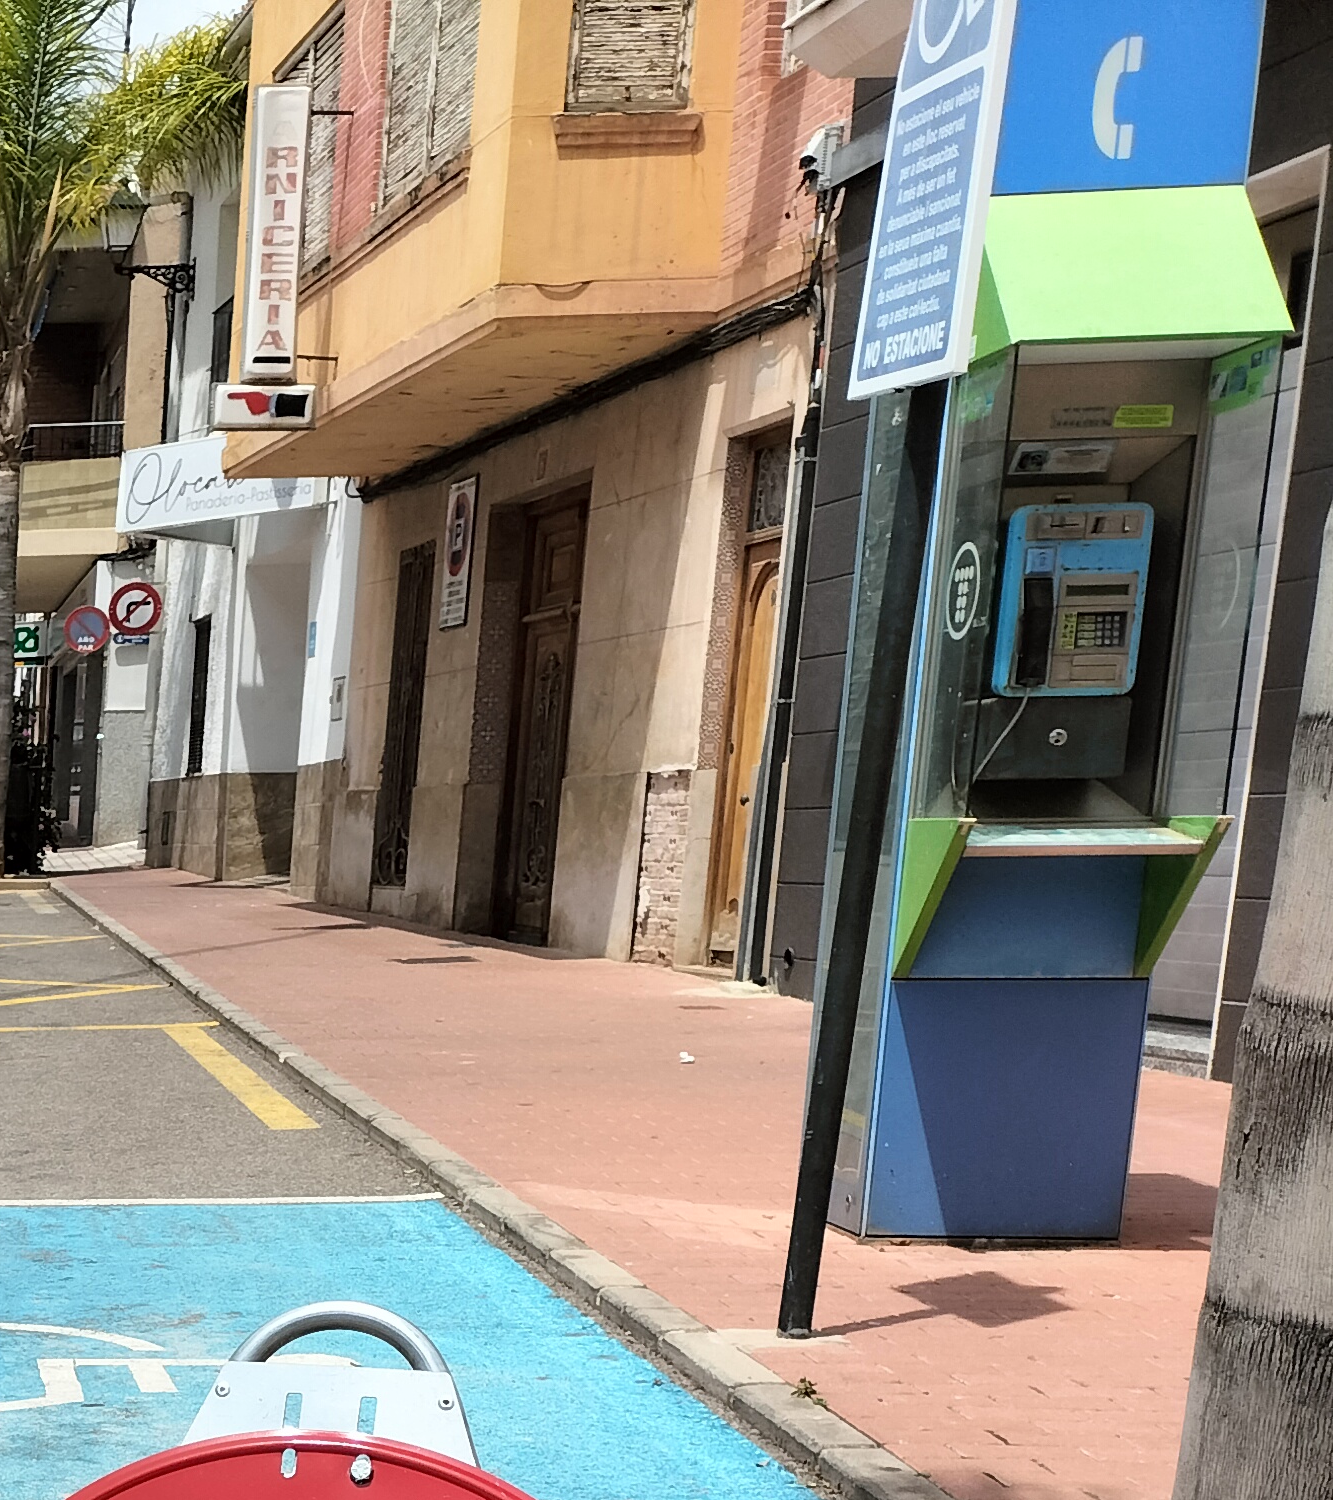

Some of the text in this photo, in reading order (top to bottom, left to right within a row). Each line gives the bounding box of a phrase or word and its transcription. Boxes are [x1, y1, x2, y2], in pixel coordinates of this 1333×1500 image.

[905, 107, 934, 132] estacione
[935, 99, 943, 118] el
[942, 97, 955, 115] seu
[955, 83, 980, 108] vehicle
[938, 113, 967, 140] reservat
[898, 165, 912, 185] per
[916, 180, 926, 198] de
[925, 177, 937, 194] ser
[936, 174, 946, 190] un
[946, 166, 957, 185] fet
[919, 251, 932, 268] una
[932, 244, 948, 263] falta
[876, 289, 885, 306] de
[863, 320, 946, 370] NO ESTACIONE
